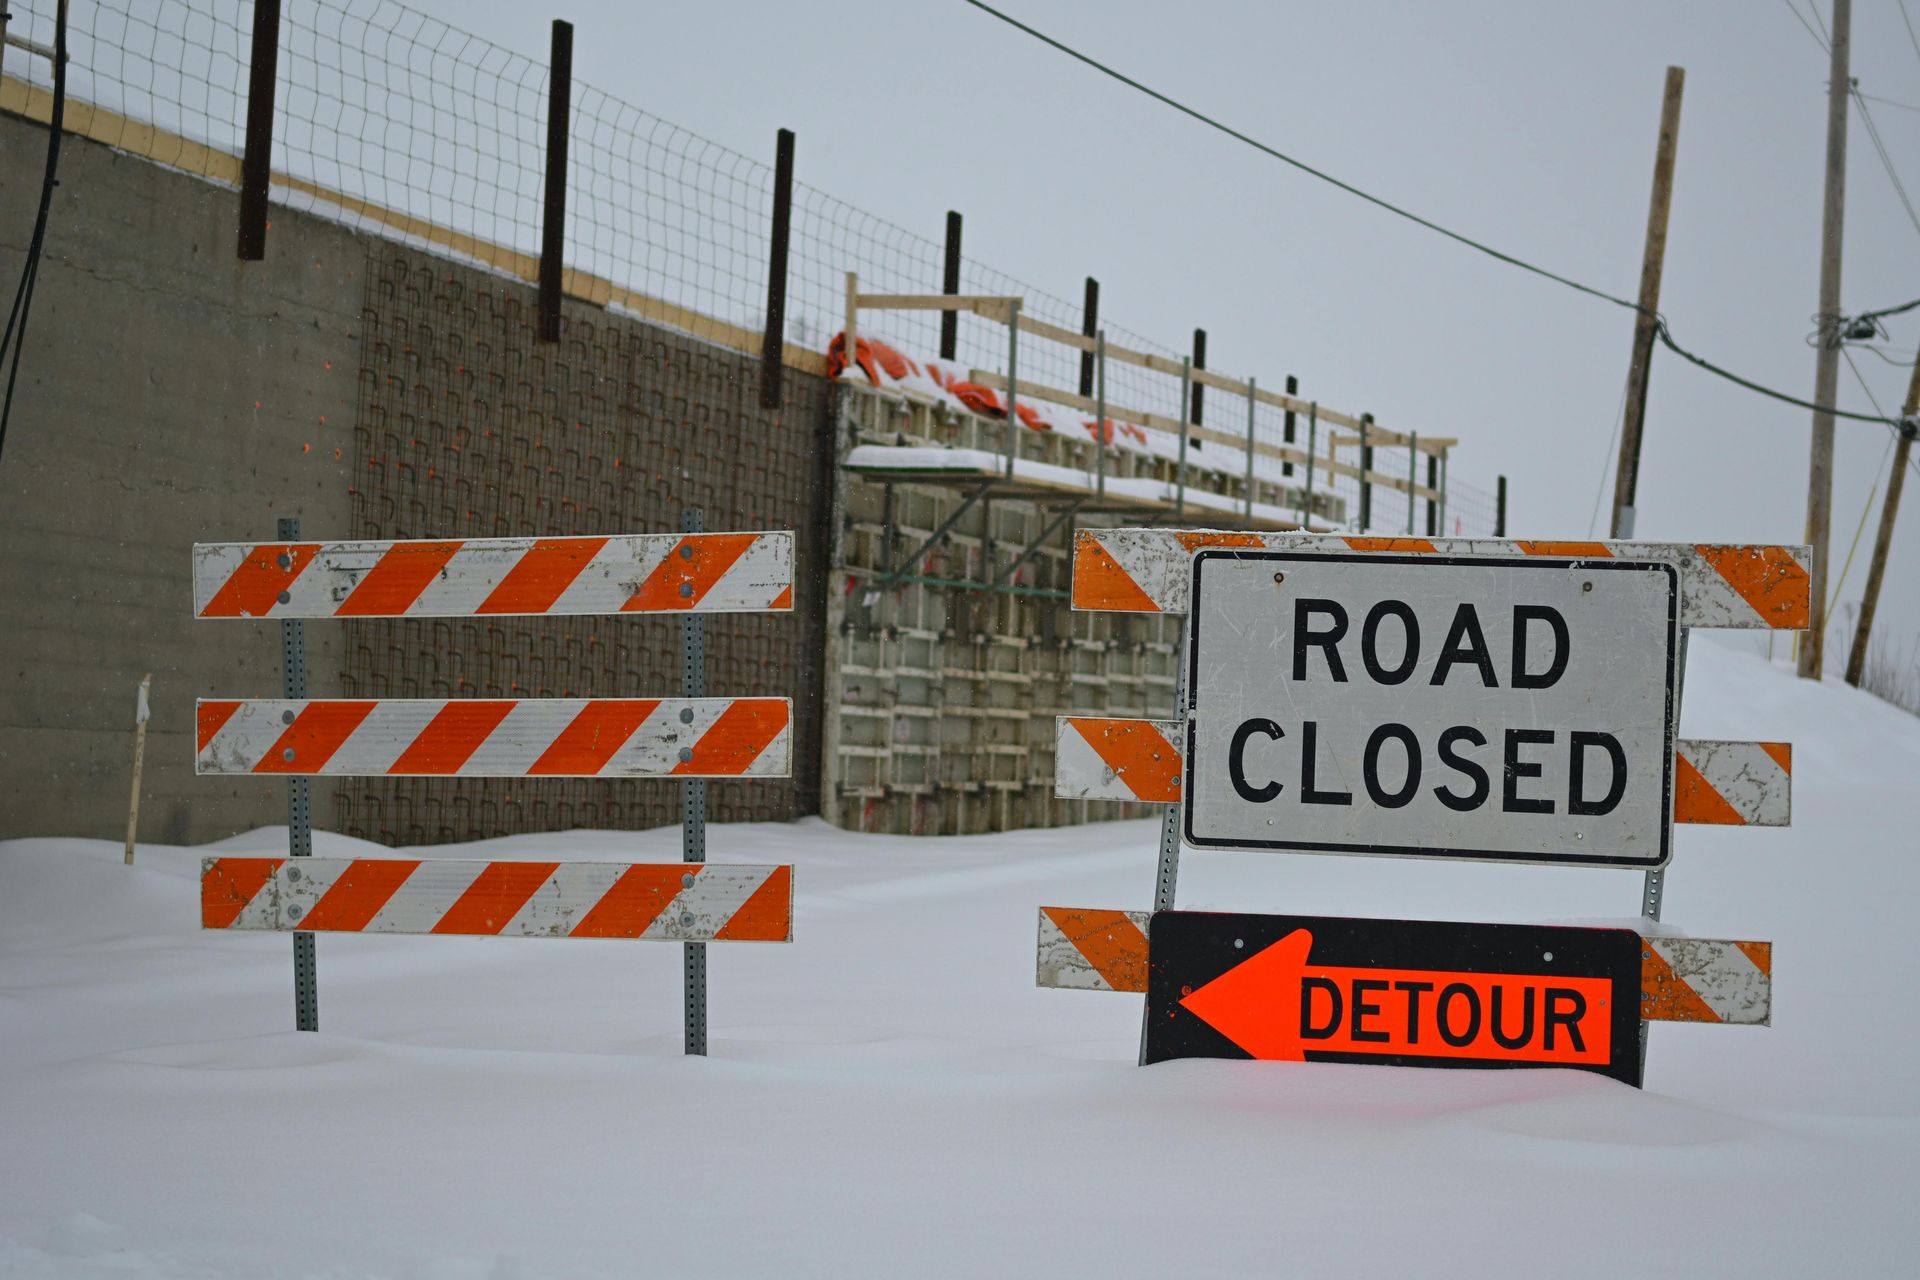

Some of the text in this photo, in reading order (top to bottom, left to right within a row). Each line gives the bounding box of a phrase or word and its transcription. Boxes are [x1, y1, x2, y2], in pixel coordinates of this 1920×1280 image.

[1293, 598, 1571, 690] ROAD
[1229, 718, 1628, 817] CLOSED
[1300, 976, 1587, 1052] DETOUR
